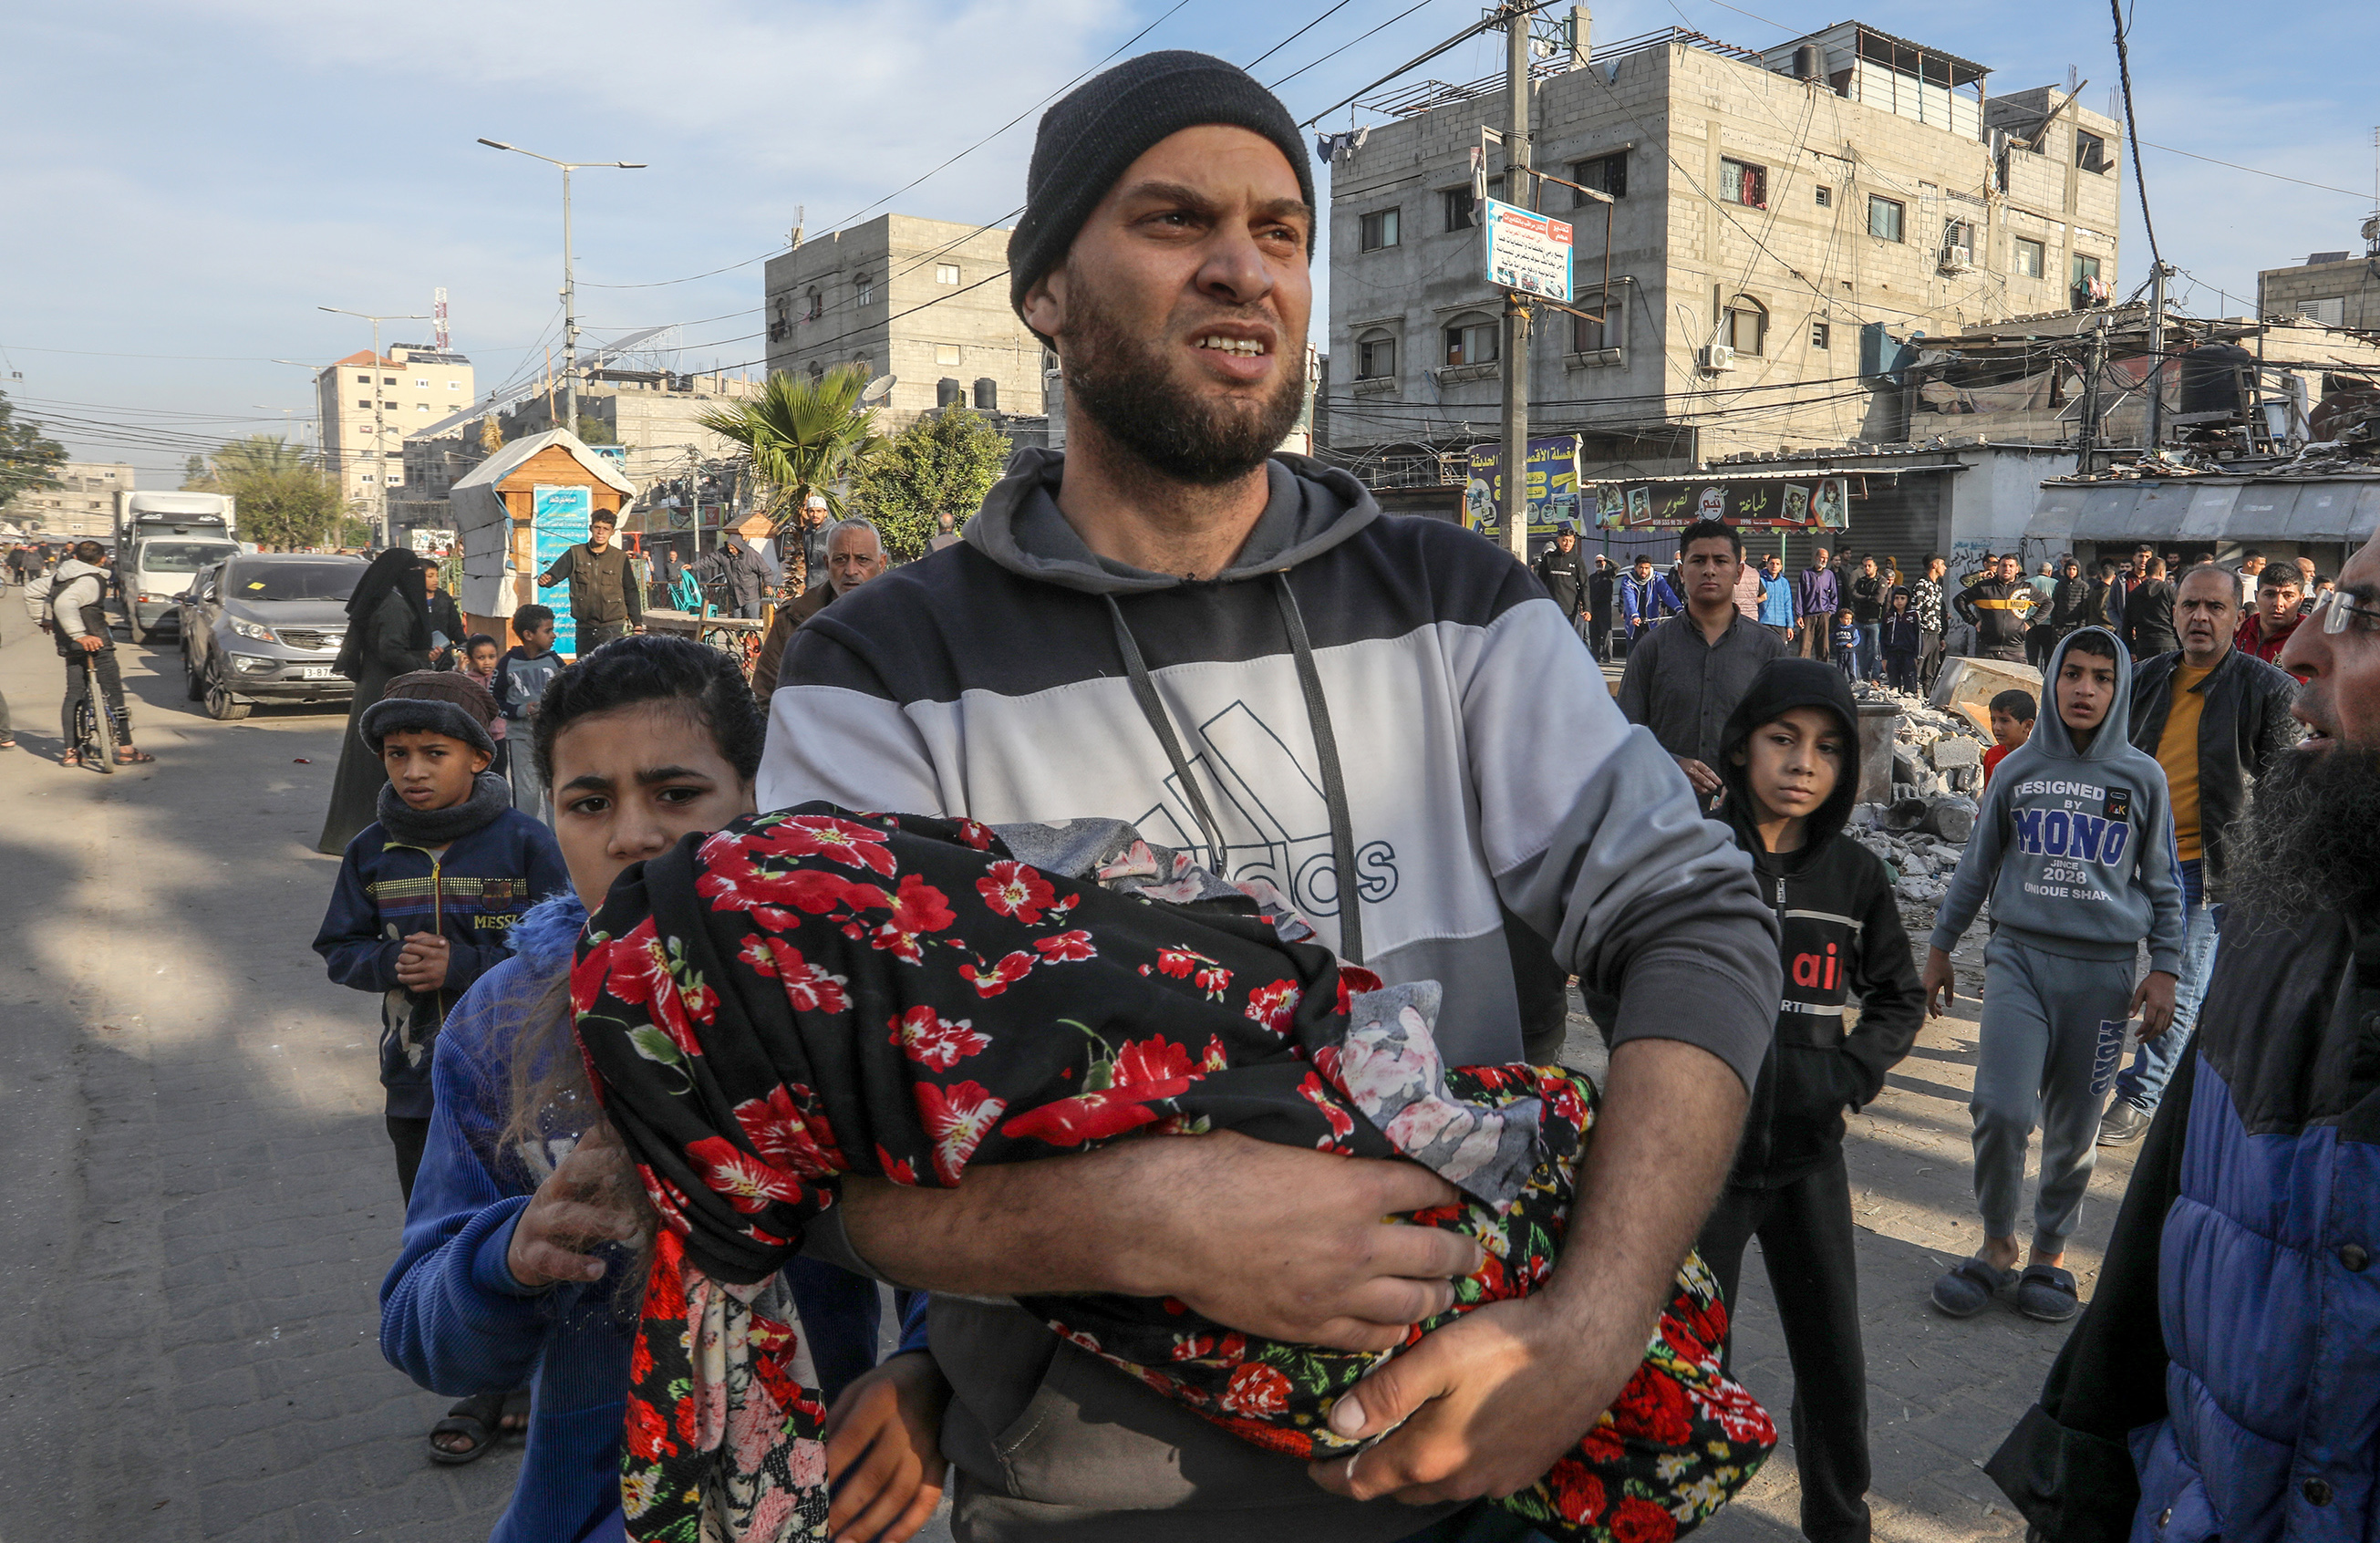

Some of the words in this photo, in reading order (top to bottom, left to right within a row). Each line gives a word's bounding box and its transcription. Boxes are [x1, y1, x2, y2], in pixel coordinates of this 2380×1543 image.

[1553, 223, 1568, 233] تحذير
[1556, 233, 1568, 241] مهم
[1471, 453, 1498, 471] الحديثة
[1526, 447, 1549, 463] الأقص
[1661, 486, 1691, 519] تصوير
[1738, 488, 1767, 517] طباعة
[2013, 781, 2106, 801] DESIGNED
[2064, 800, 2083, 810] BY
[2108, 803, 2126, 815] K&K
[2010, 807, 2131, 867] MONO
[2043, 867, 2087, 885] 2028
[2072, 889, 2114, 902] SHAP
[1781, 999, 1802, 1013] RT
